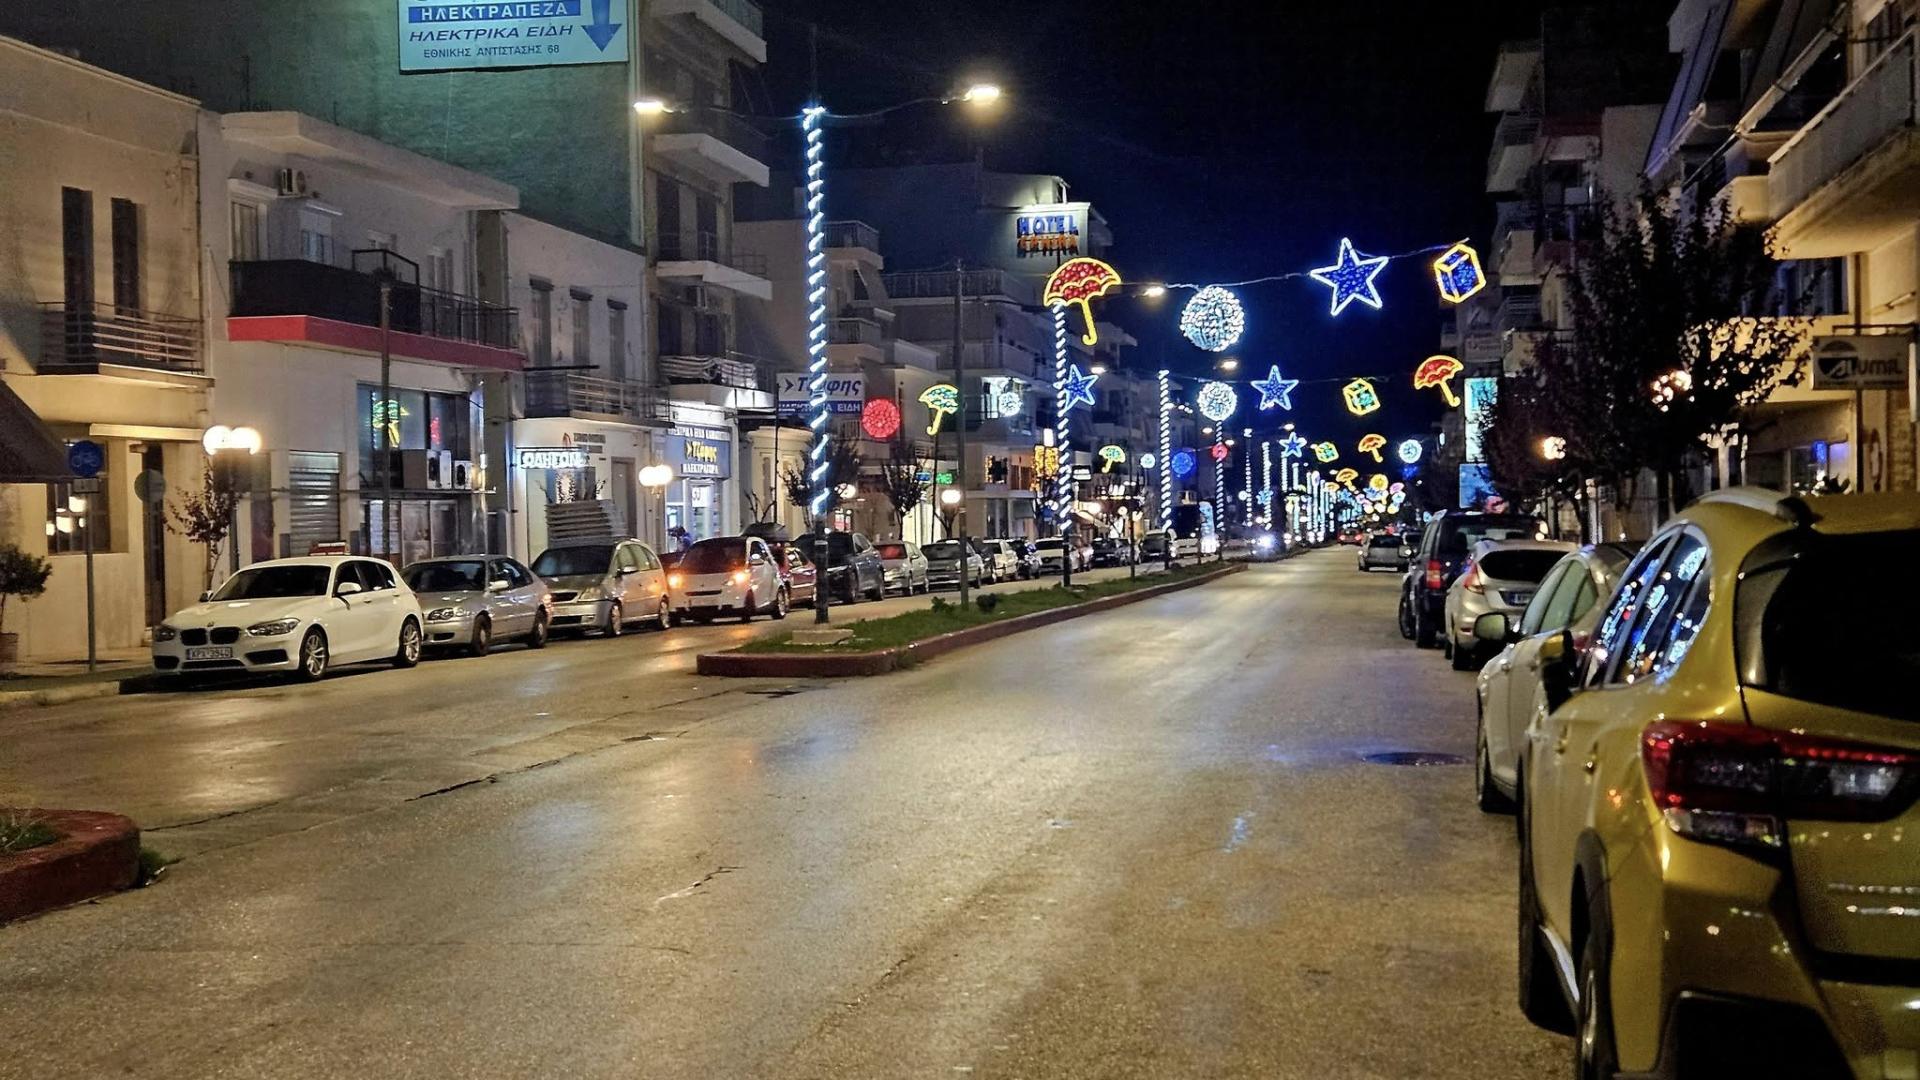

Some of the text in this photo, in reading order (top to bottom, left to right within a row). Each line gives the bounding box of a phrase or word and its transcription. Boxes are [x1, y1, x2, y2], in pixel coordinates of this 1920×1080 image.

[421, 2, 568, 21] ΗΛΕΚΤΡΑΠΕΖΑ
[409, 25, 573, 42] ΗΛΕΚΤΡΙΚΑ ΕΙΔΗ
[423, 44, 560, 59] ΕΘΝΙΚΗΣ ΑΝΤΙΣΤΑΣΗΣ 68
[1017, 215, 1078, 235] HOTEL
